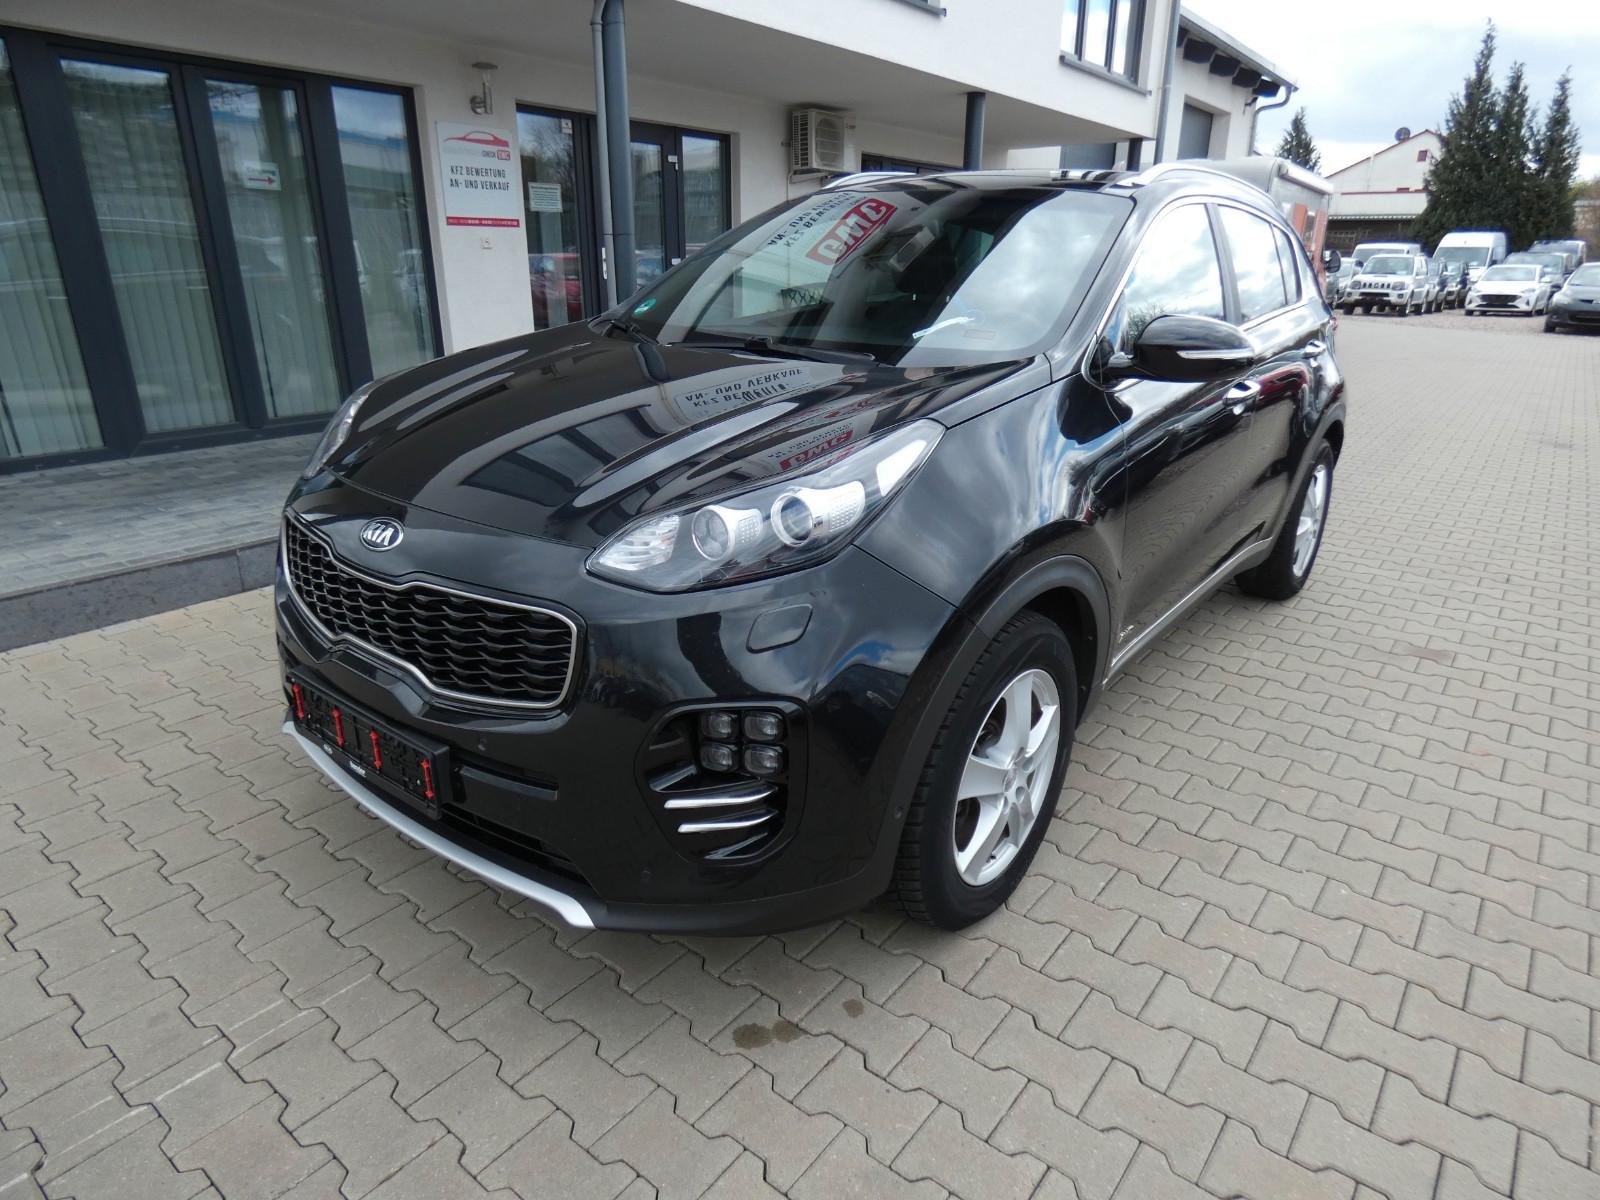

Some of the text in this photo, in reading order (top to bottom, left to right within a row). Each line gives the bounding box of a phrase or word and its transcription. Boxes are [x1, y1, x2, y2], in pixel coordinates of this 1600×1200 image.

[450, 165, 506, 179] KFZ BEWERTUNG
[450, 178, 510, 191] AN- UND VERKAUF
[362, 523, 394, 546] KIA
